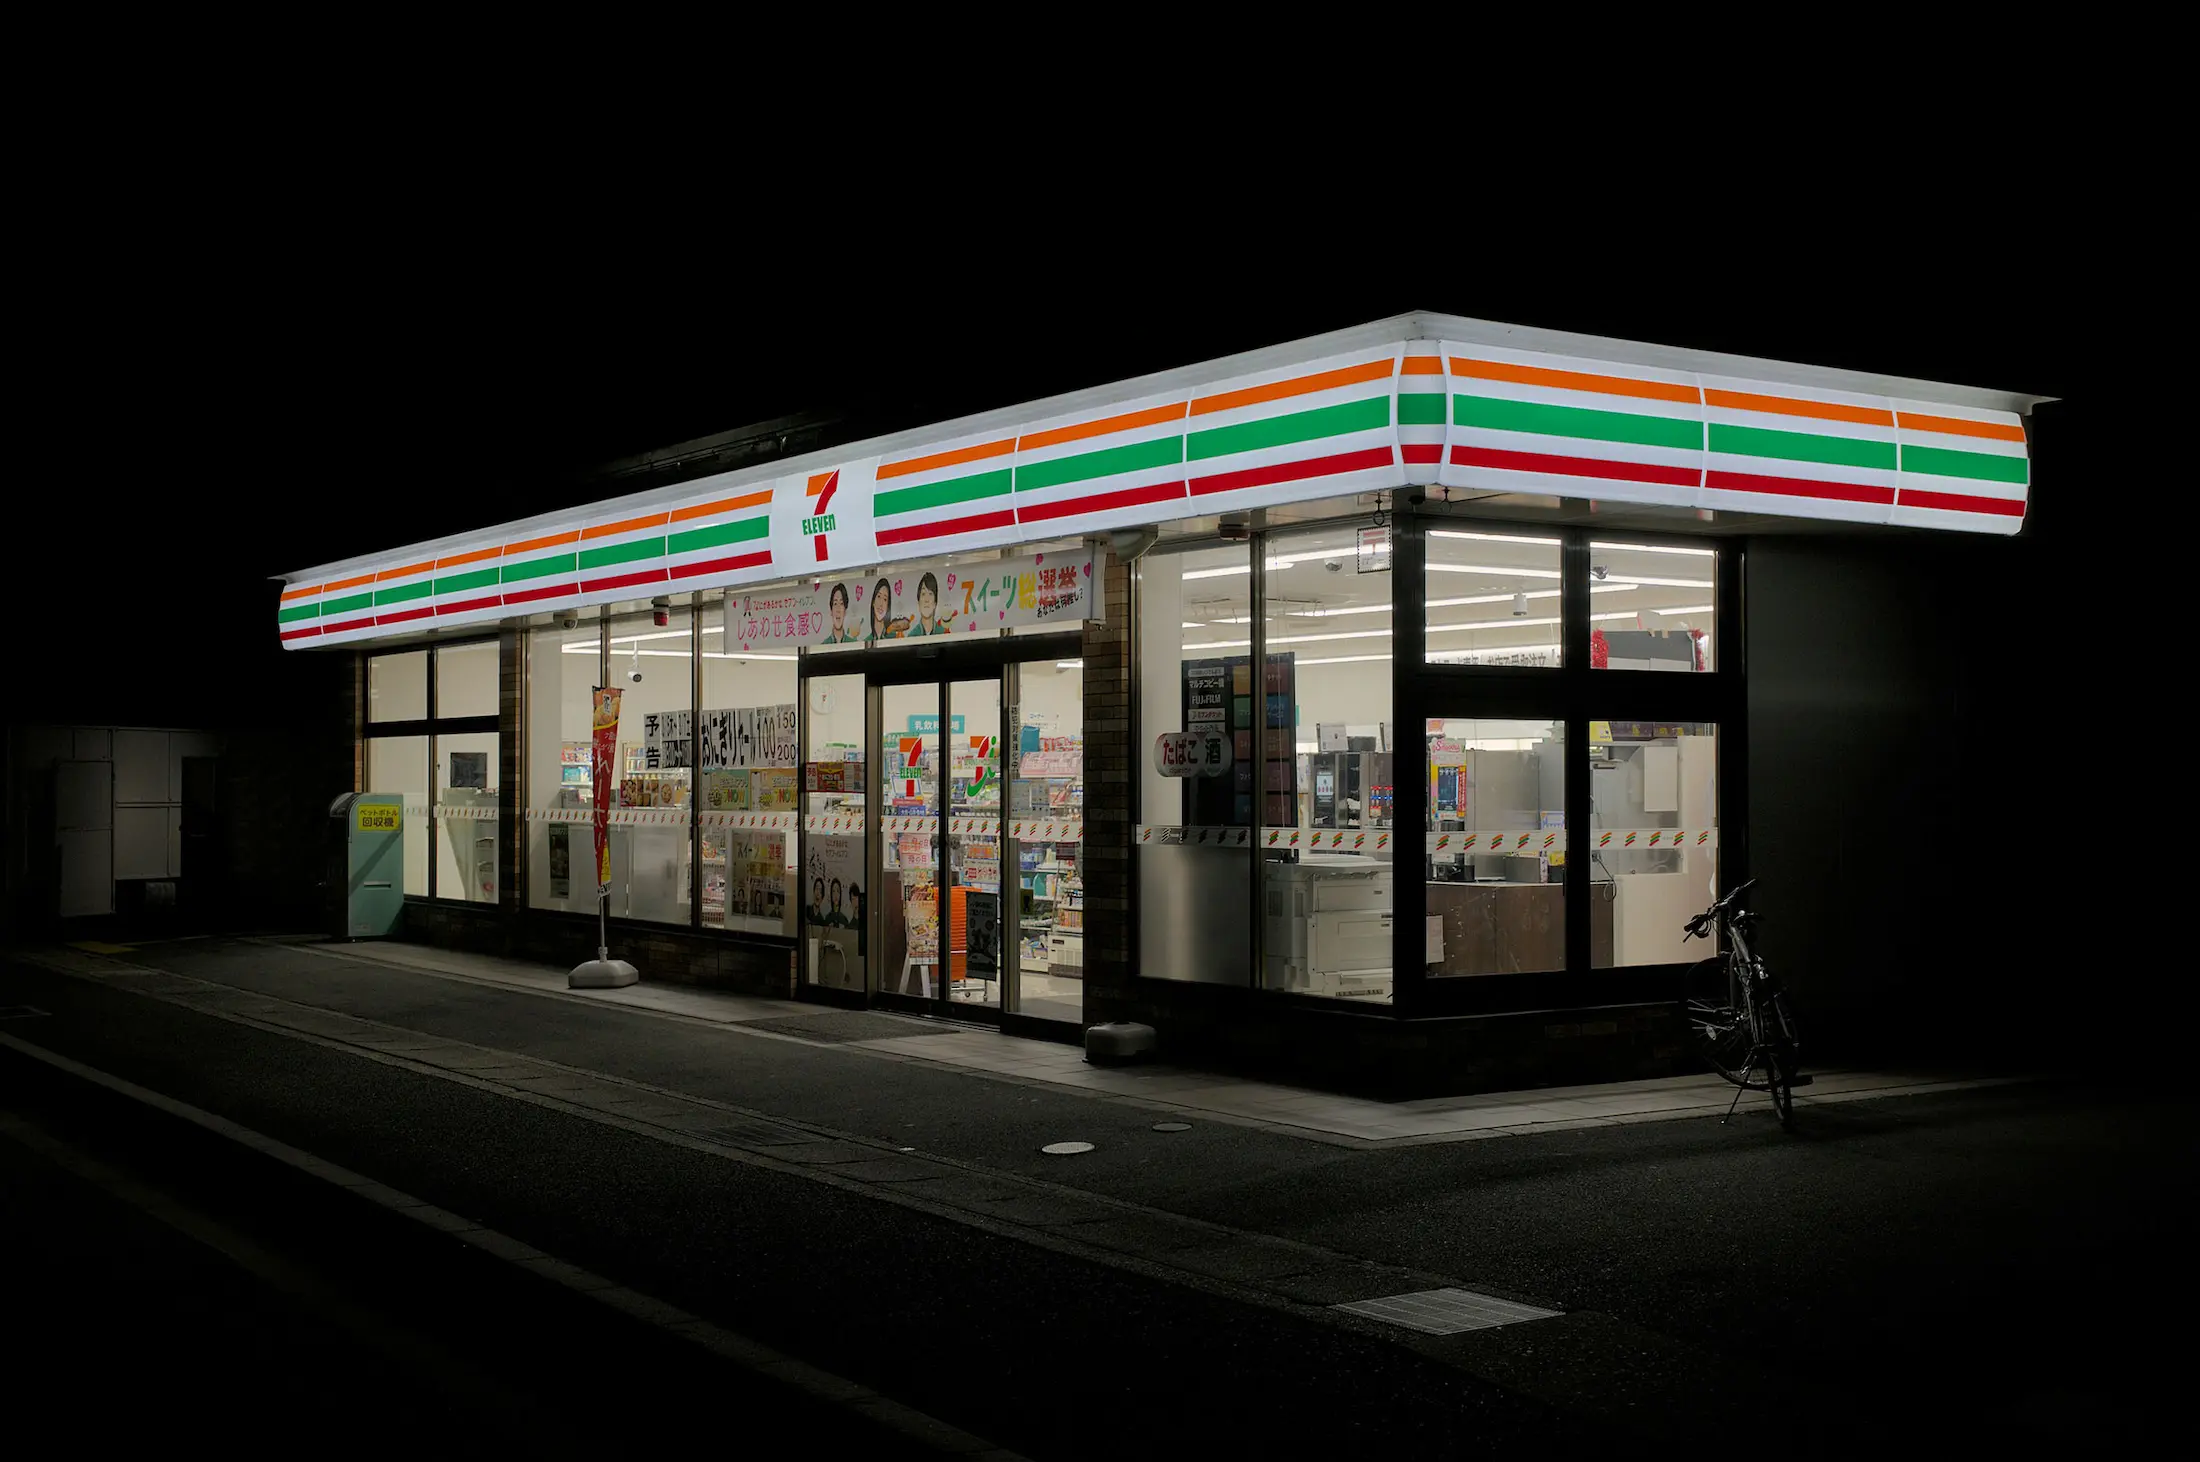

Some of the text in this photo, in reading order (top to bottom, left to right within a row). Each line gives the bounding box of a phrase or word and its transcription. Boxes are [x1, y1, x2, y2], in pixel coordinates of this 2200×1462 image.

[805, 468, 840, 562] 7
[777, 744, 796, 761] 200
[1163, 738, 1221, 765] たばこ 酒
[362, 817, 394, 828] 回収機
